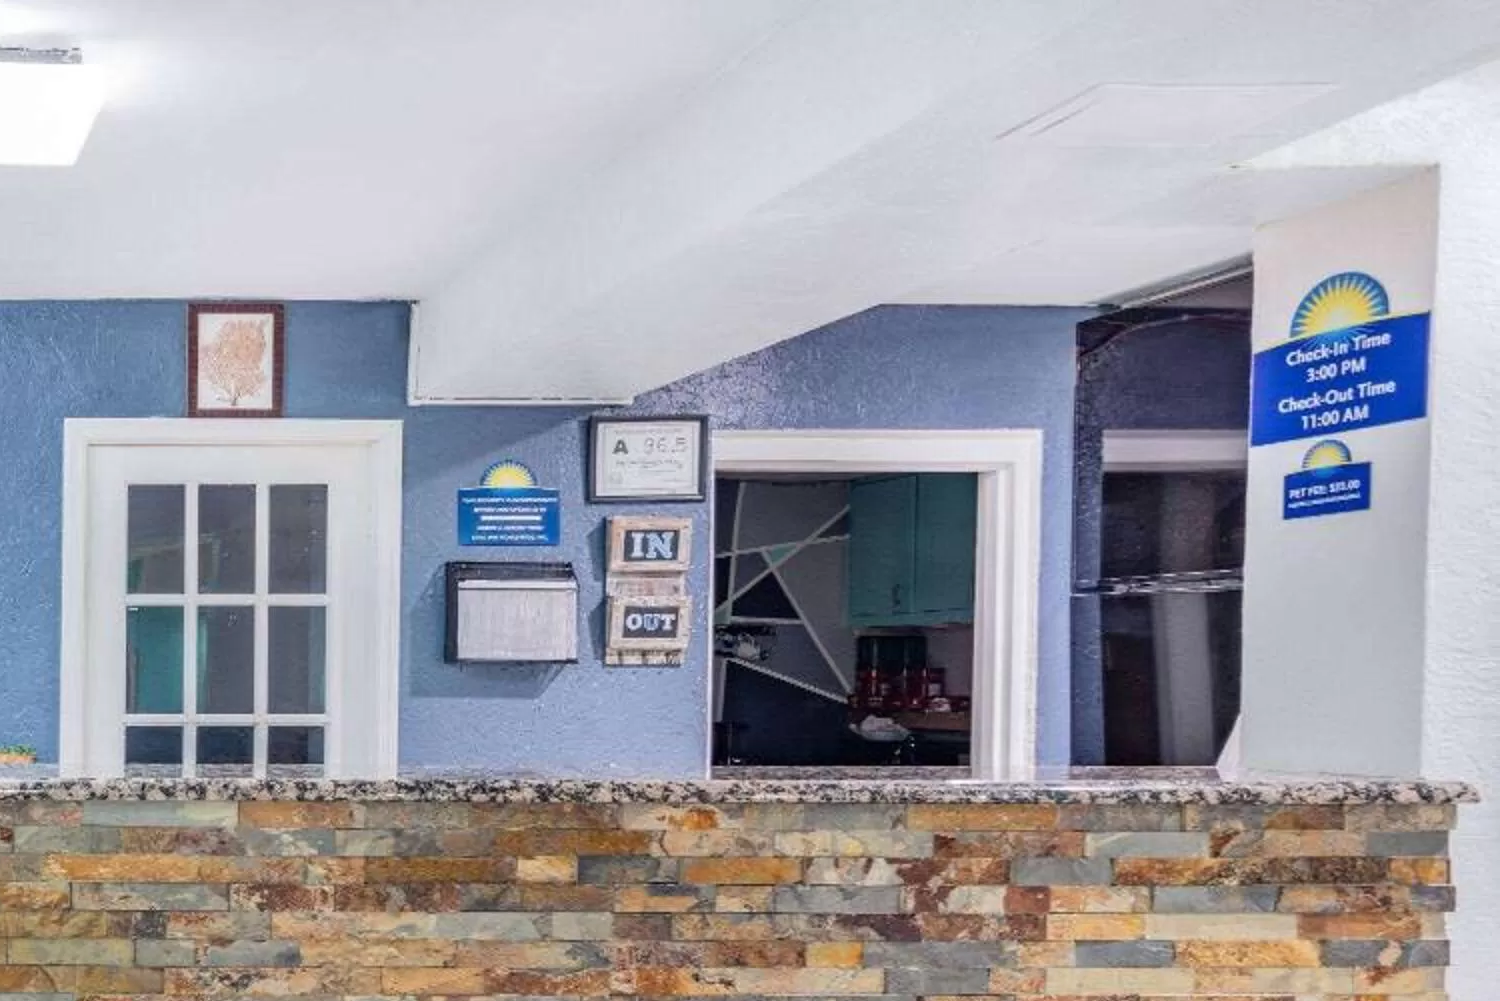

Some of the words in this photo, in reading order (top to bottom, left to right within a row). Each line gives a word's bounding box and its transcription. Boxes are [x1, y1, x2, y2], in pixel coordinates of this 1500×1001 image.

[1286, 341, 1349, 366] Check-In
[1353, 333, 1391, 351] Time
[1306, 363, 1337, 383] 3:00
[1341, 356, 1367, 375] PM
[1278, 388, 1354, 413] Check-Out
[1357, 381, 1396, 398] Time
[1301, 410, 1340, 430] 11:00
[1342, 404, 1369, 422] AM
[612, 439, 628, 455] A
[630, 532, 674, 558] IN
[625, 613, 676, 631] OUT
